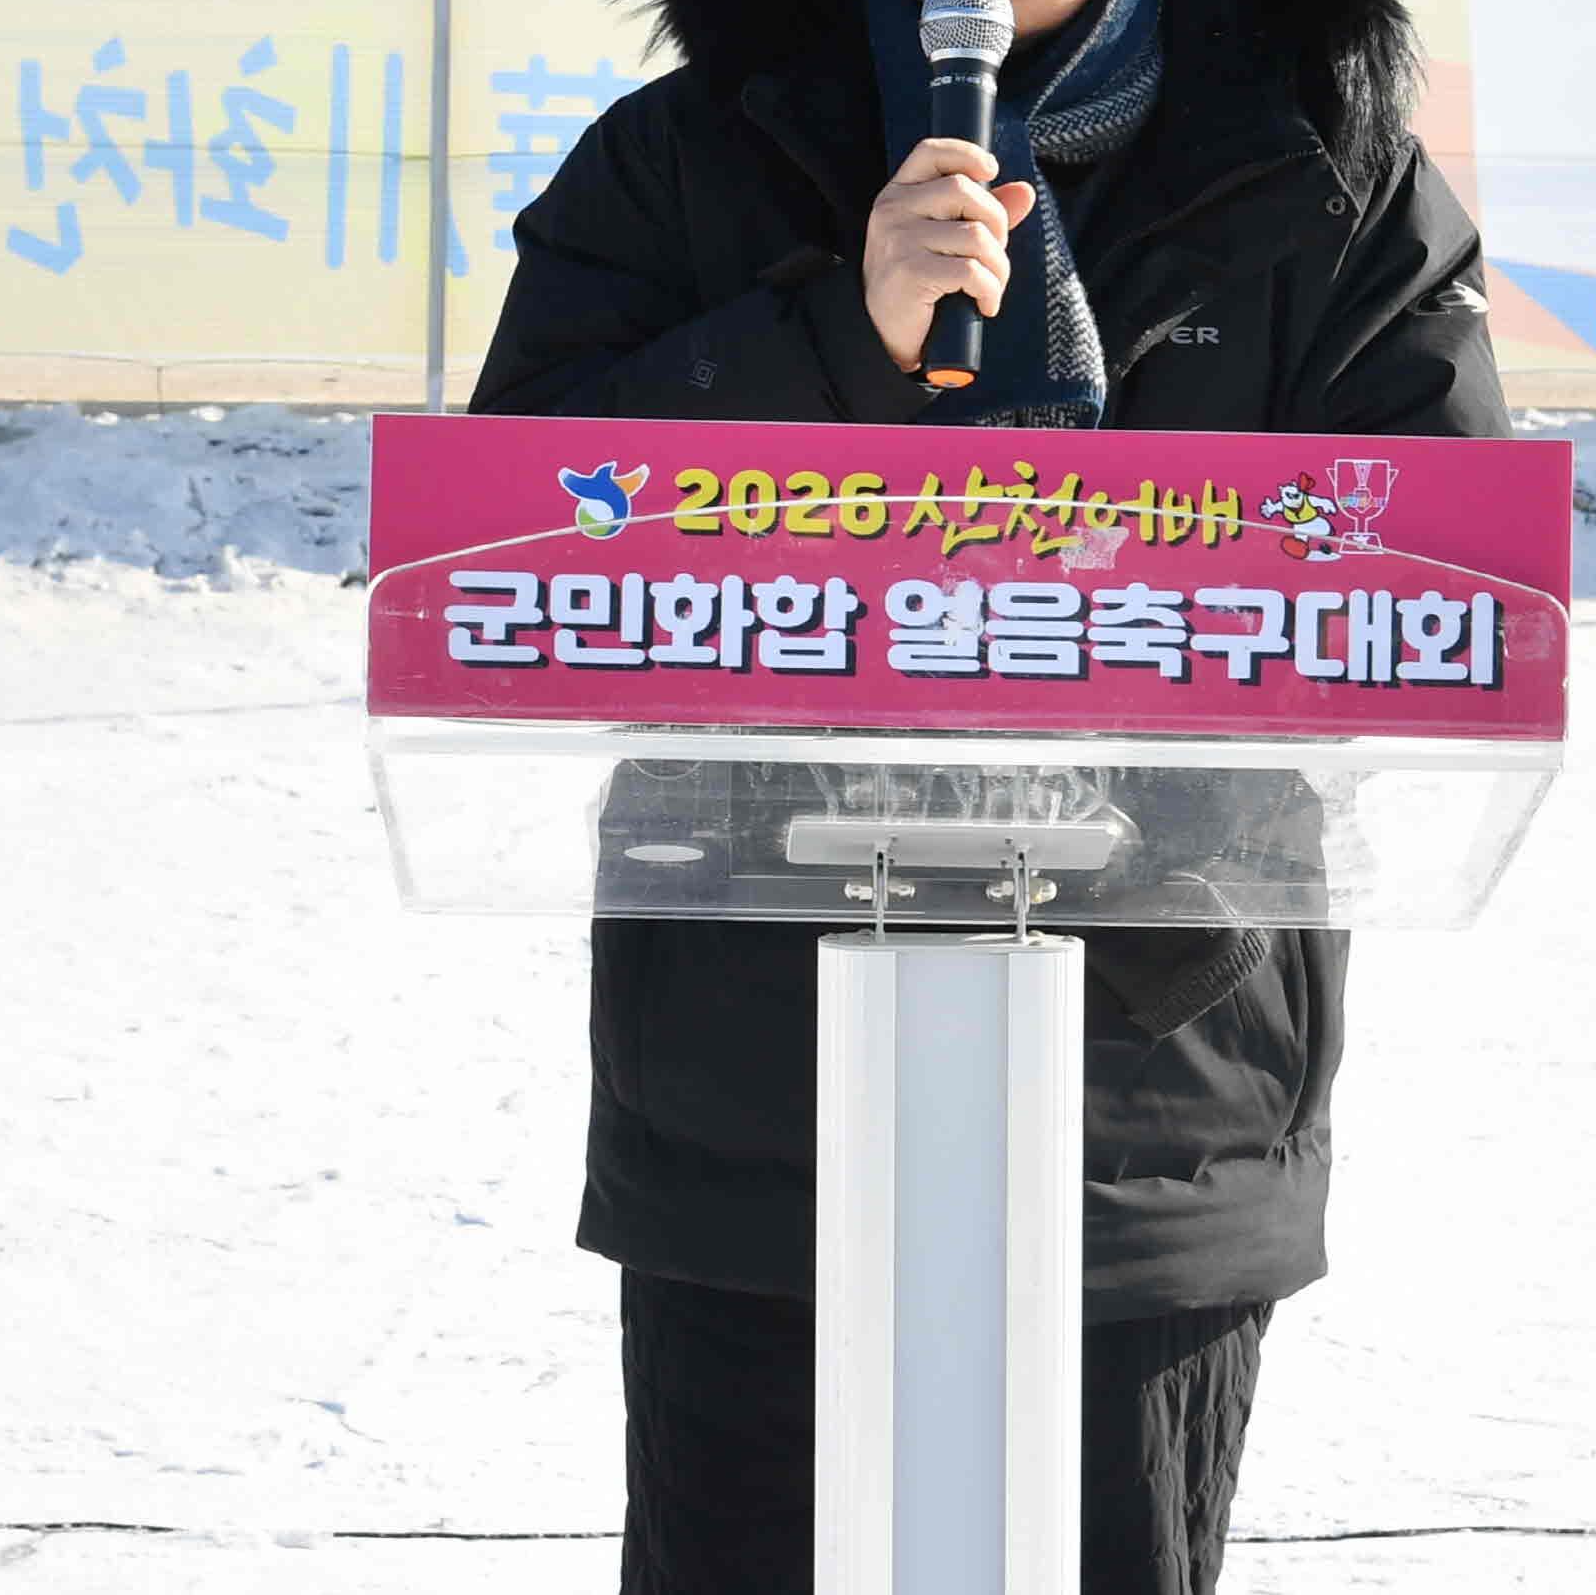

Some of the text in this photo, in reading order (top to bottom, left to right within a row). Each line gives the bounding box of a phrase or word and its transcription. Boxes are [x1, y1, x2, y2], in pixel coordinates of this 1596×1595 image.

[673, 461, 1243, 556] 2026 산천어배
[444, 570, 1497, 686] 군민화합 얼음축구대회
